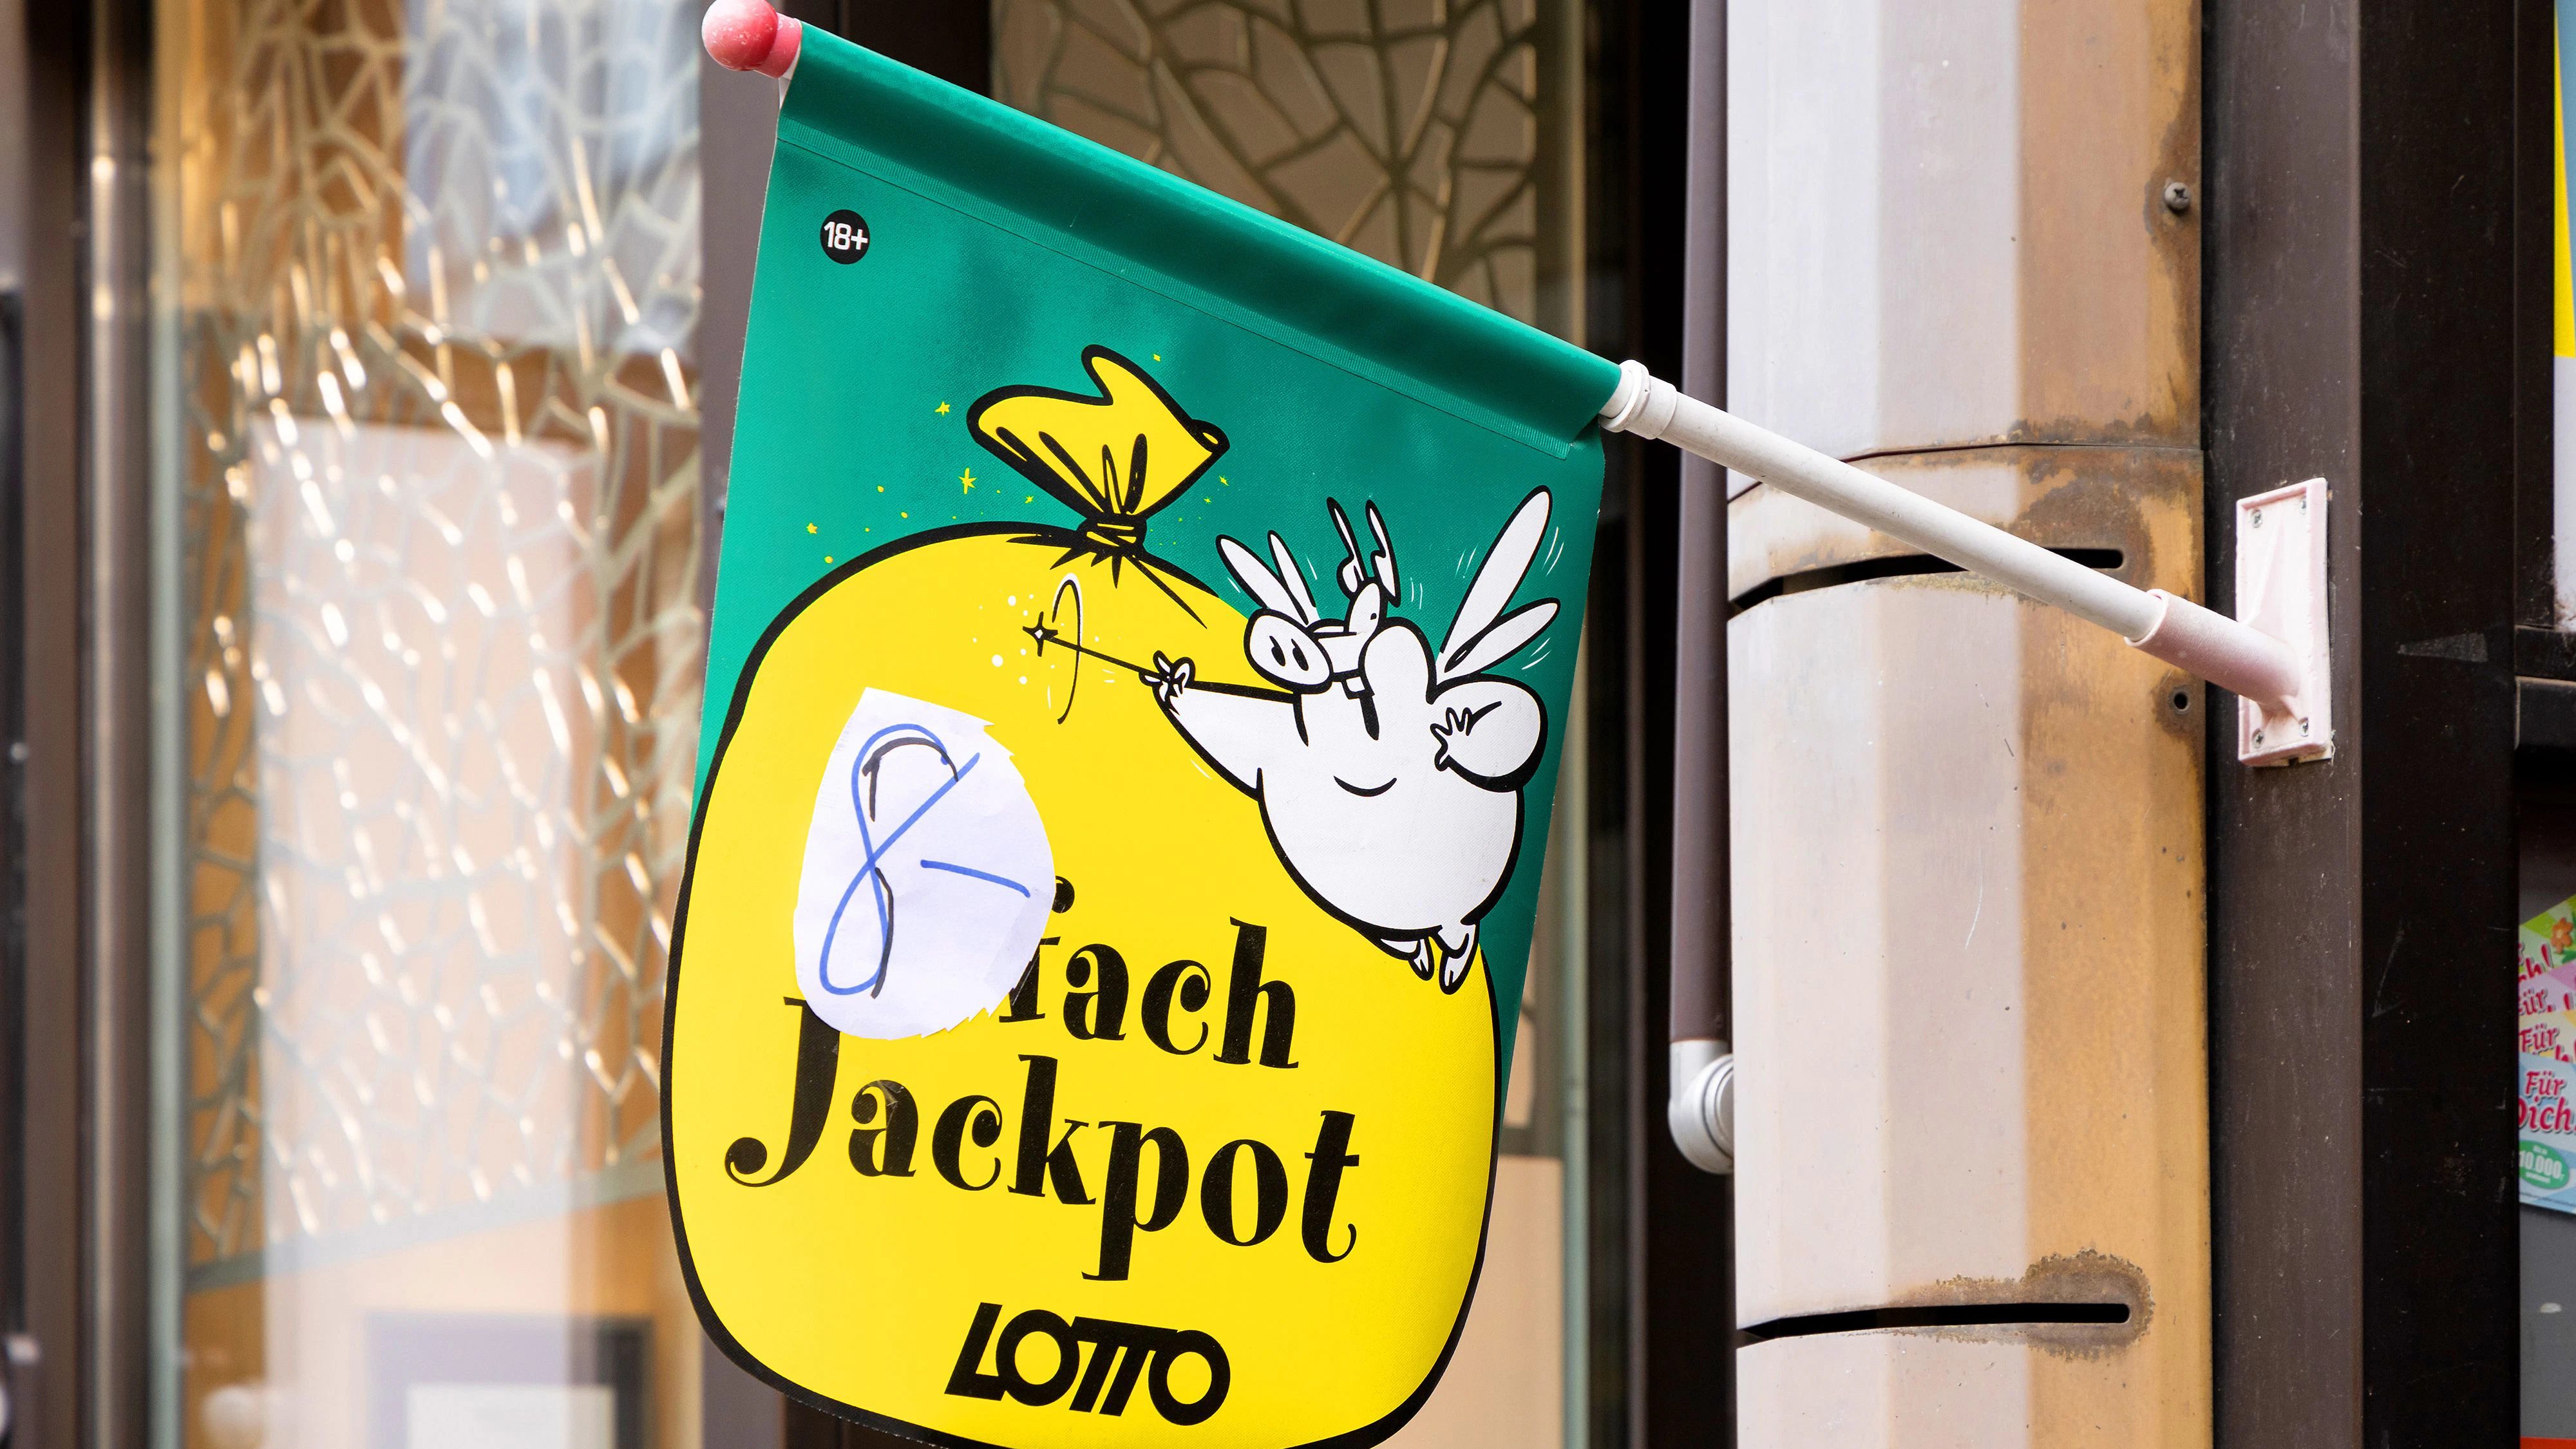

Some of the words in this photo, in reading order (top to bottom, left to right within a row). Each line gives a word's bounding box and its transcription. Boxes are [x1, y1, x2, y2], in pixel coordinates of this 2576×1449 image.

[824, 221, 868, 251] 18+
[2519, 989, 2547, 1016] ür
[2519, 1023, 2559, 1053] Für
[2525, 1070, 2565, 1096] Für
[2519, 1096, 2576, 1132] ich
[724, 997, 1359, 1282] Jackpot
[944, 1302, 1231, 1426] LOTTO
